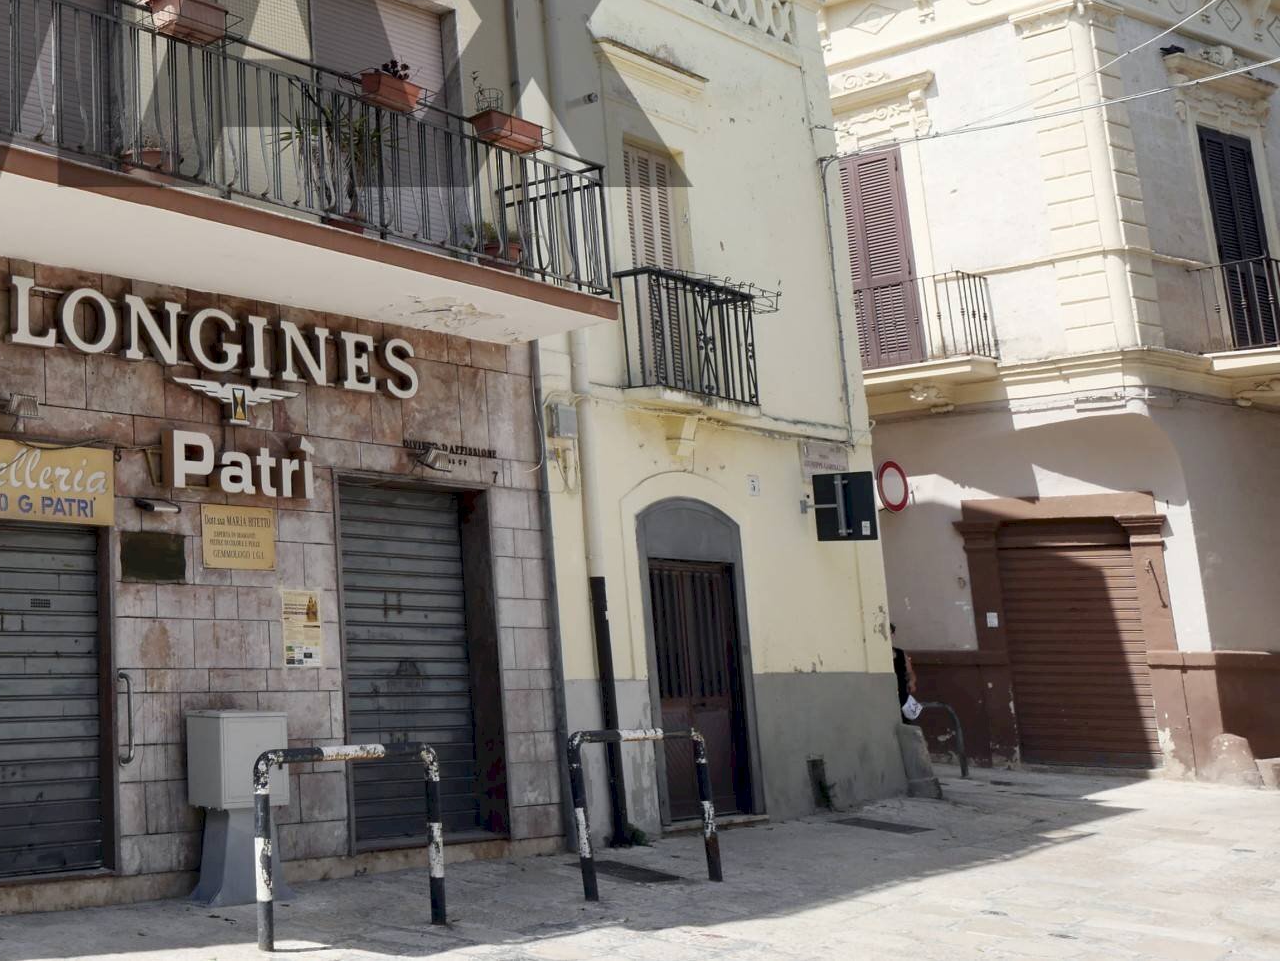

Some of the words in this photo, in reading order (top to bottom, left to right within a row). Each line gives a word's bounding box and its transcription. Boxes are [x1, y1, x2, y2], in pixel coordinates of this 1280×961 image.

[10, 275, 420, 400] LONGINES
[491, 470, 499, 484] 7
[18, 494, 37, 514] G.
